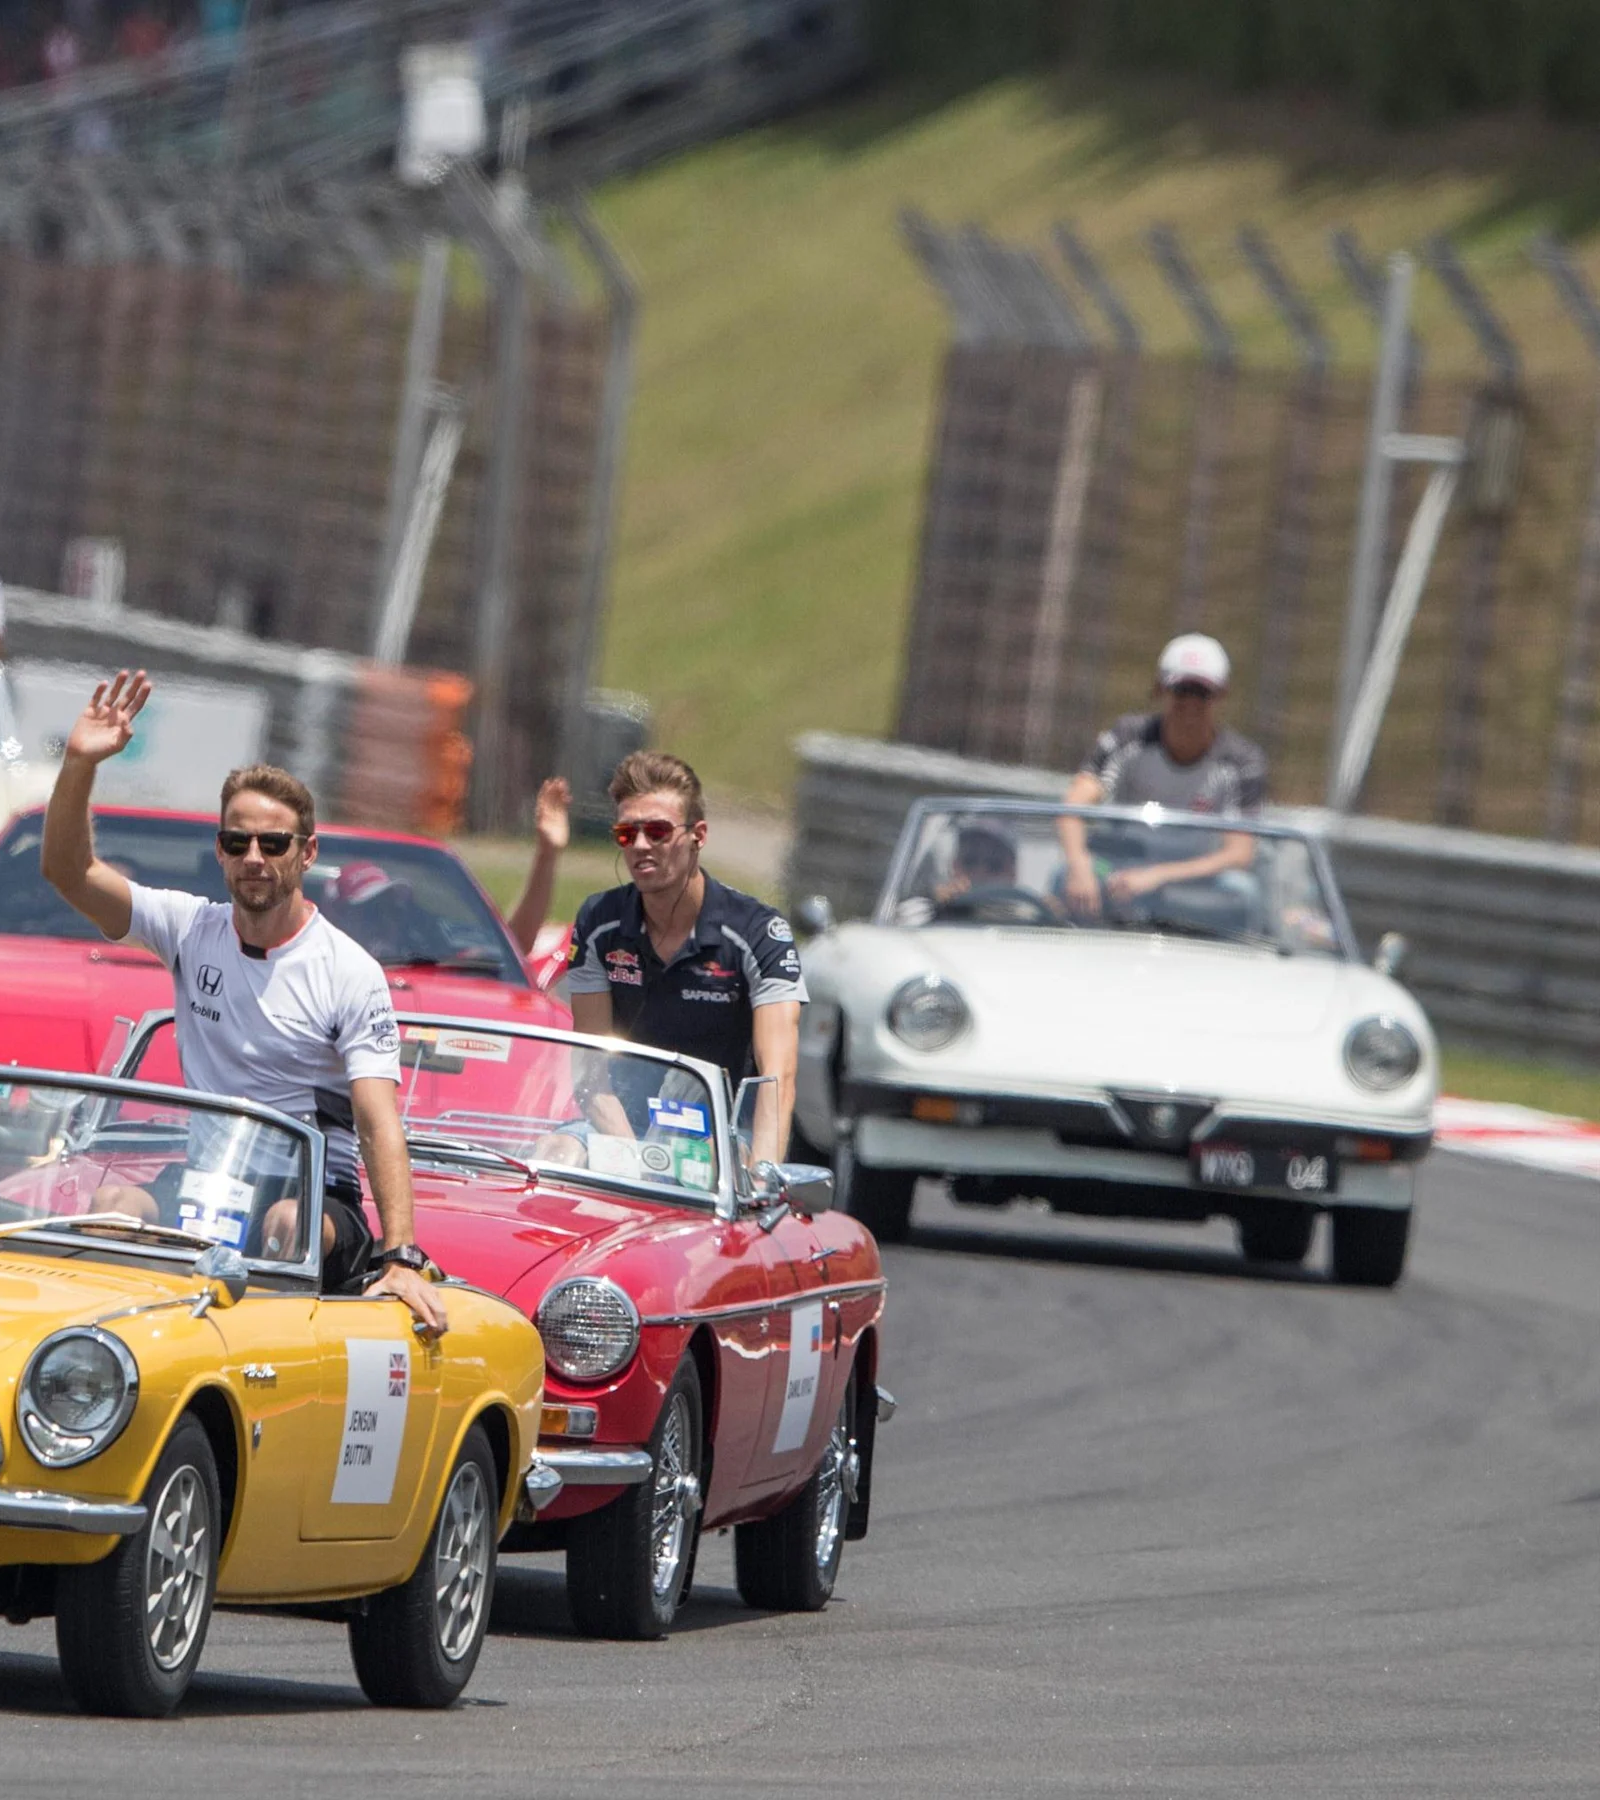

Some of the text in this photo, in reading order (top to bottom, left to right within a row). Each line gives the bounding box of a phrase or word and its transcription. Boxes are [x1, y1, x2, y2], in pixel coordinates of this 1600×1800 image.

[681, 988, 731, 1003] SAPINDA
[348, 1410, 379, 1432] JENSON
[343, 1444, 374, 1466] BUTTON
